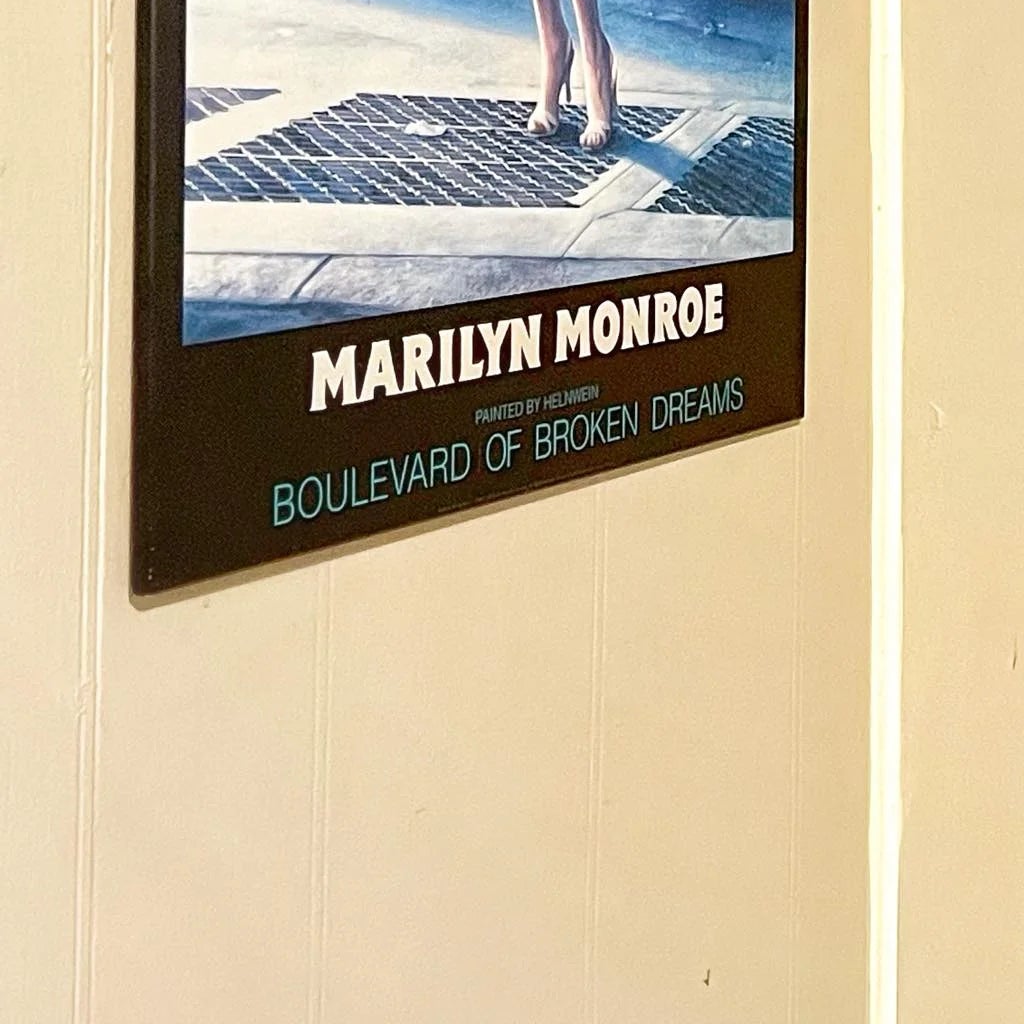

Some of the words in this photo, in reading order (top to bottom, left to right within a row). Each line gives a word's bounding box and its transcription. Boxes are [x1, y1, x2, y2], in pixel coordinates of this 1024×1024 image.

[309, 313, 543, 412] MARILYN
[554, 282, 725, 363] MONROE
[474, 401, 524, 425] PAINTED
[526, 395, 542, 415] BY
[543, 384, 600, 409] HELNWEIN
[272, 442, 472, 527] BOULEVARD
[485, 428, 523, 472] OF
[534, 401, 639, 461] BROKEN
[651, 377, 745, 431] DREAMS
